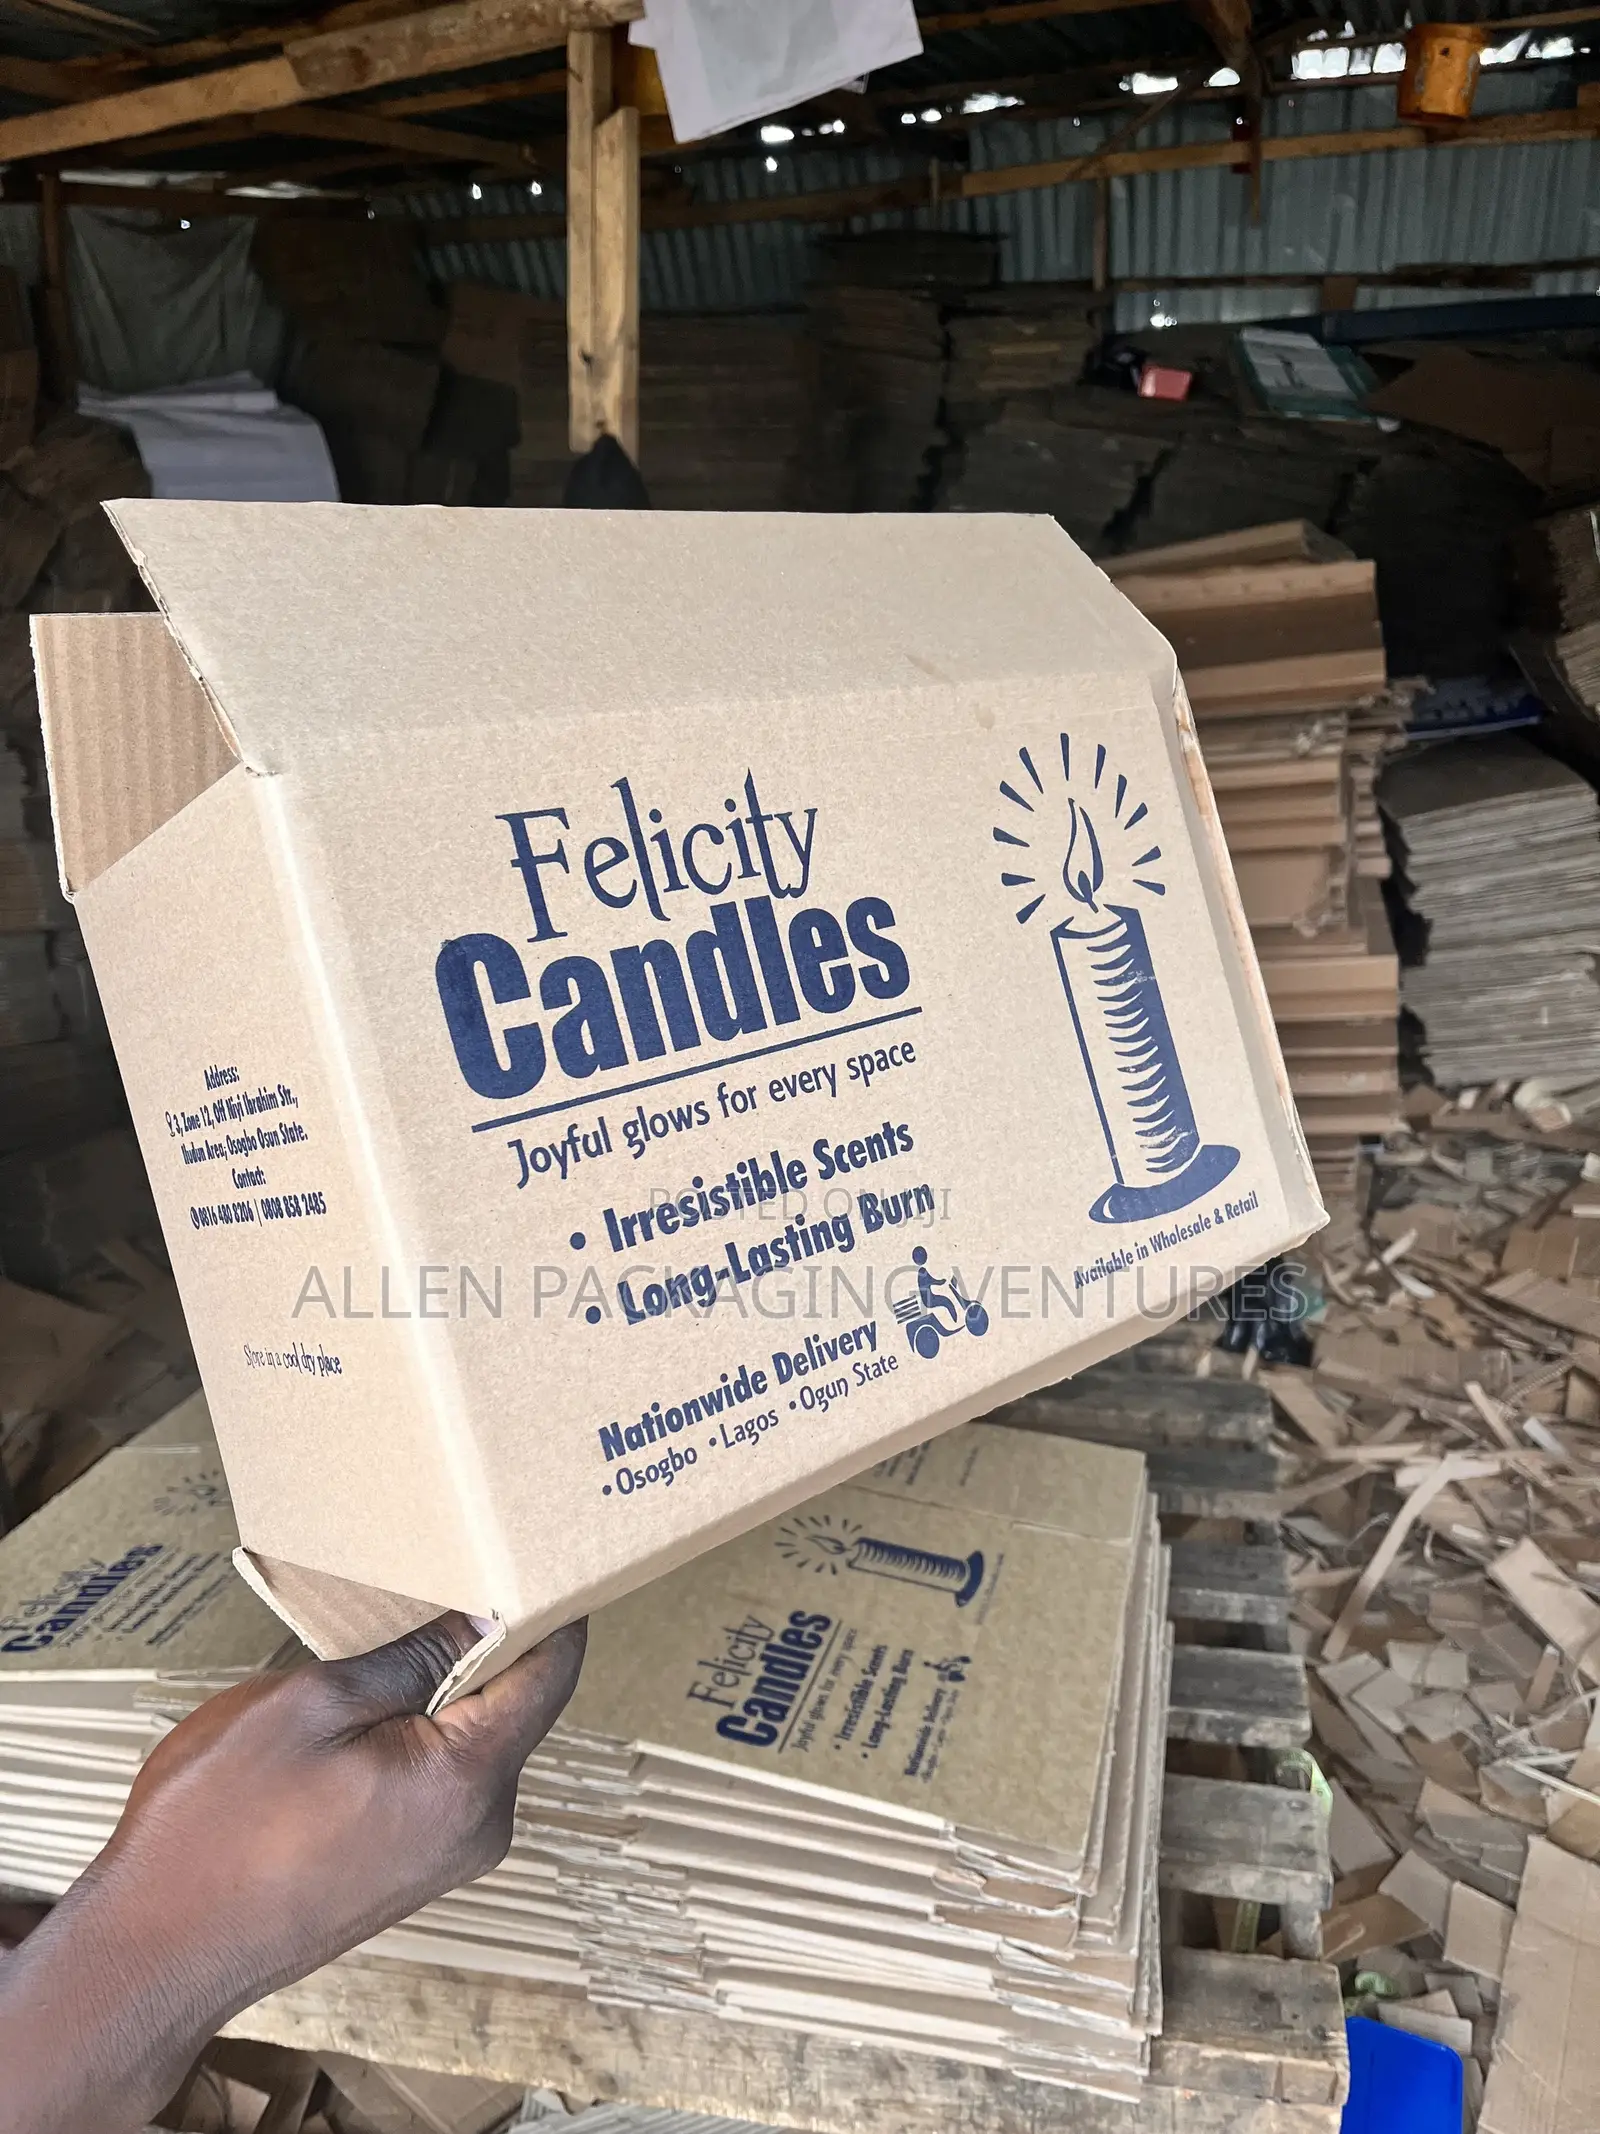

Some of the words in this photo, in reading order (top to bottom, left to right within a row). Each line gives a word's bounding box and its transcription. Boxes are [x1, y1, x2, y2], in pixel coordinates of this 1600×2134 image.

[495, 768, 818, 943] Felicity
[435, 895, 910, 1099] Candles
[181, 1111, 201, 1132] Zone
[213, 1099, 227, 1124] Off
[226, 1094, 245, 1122] Niyi
[243, 1086, 280, 1116] Ibrahim
[204, 1064, 240, 1091] Address:
[508, 1117, 613, 1189] Joyful
[622, 1097, 711, 1158] glows
[717, 1082, 757, 1118] for
[768, 1061, 837, 1103] every
[848, 1038, 916, 1087] space
[226, 1129, 258, 1158] Osogbo
[257, 1127, 280, 1150] Osun
[232, 1166, 267, 1189] Contact:
[603, 1150, 807, 1253] Irresistible
[812, 1121, 914, 1180] Scents
[232, 1200, 254, 1223] 8206
[260, 1197, 284, 1220] 0808
[282, 1194, 302, 1218] 858
[301, 1191, 327, 1215] 2485
[617, 1214, 855, 1326] Long-Lasting
[857, 1183, 936, 1234] Burn
[1073, 1248, 1134, 1290] Available
[1134, 1242, 1150, 1261] in
[1149, 1213, 1212, 1254] Wholesale
[1213, 1207, 1225, 1226] &
[1225, 1190, 1260, 1221] Retail
[243, 1343, 265, 1369] Store
[264, 1347, 277, 1370] in
[274, 1352, 282, 1367] a
[282, 1341, 303, 1374] cool
[300, 1342, 316, 1376] dry
[317, 1343, 342, 1377] place
[598, 1364, 768, 1461] Nationwide
[771, 1321, 878, 1385] Delivery
[615, 1446, 698, 1496] Osogbo
[720, 1408, 779, 1449] Lagos
[799, 1377, 849, 1413] Ogun
[852, 1354, 900, 1388] State
[686, 1614, 776, 1710] Felicity
[715, 1610, 833, 1747] Candles
